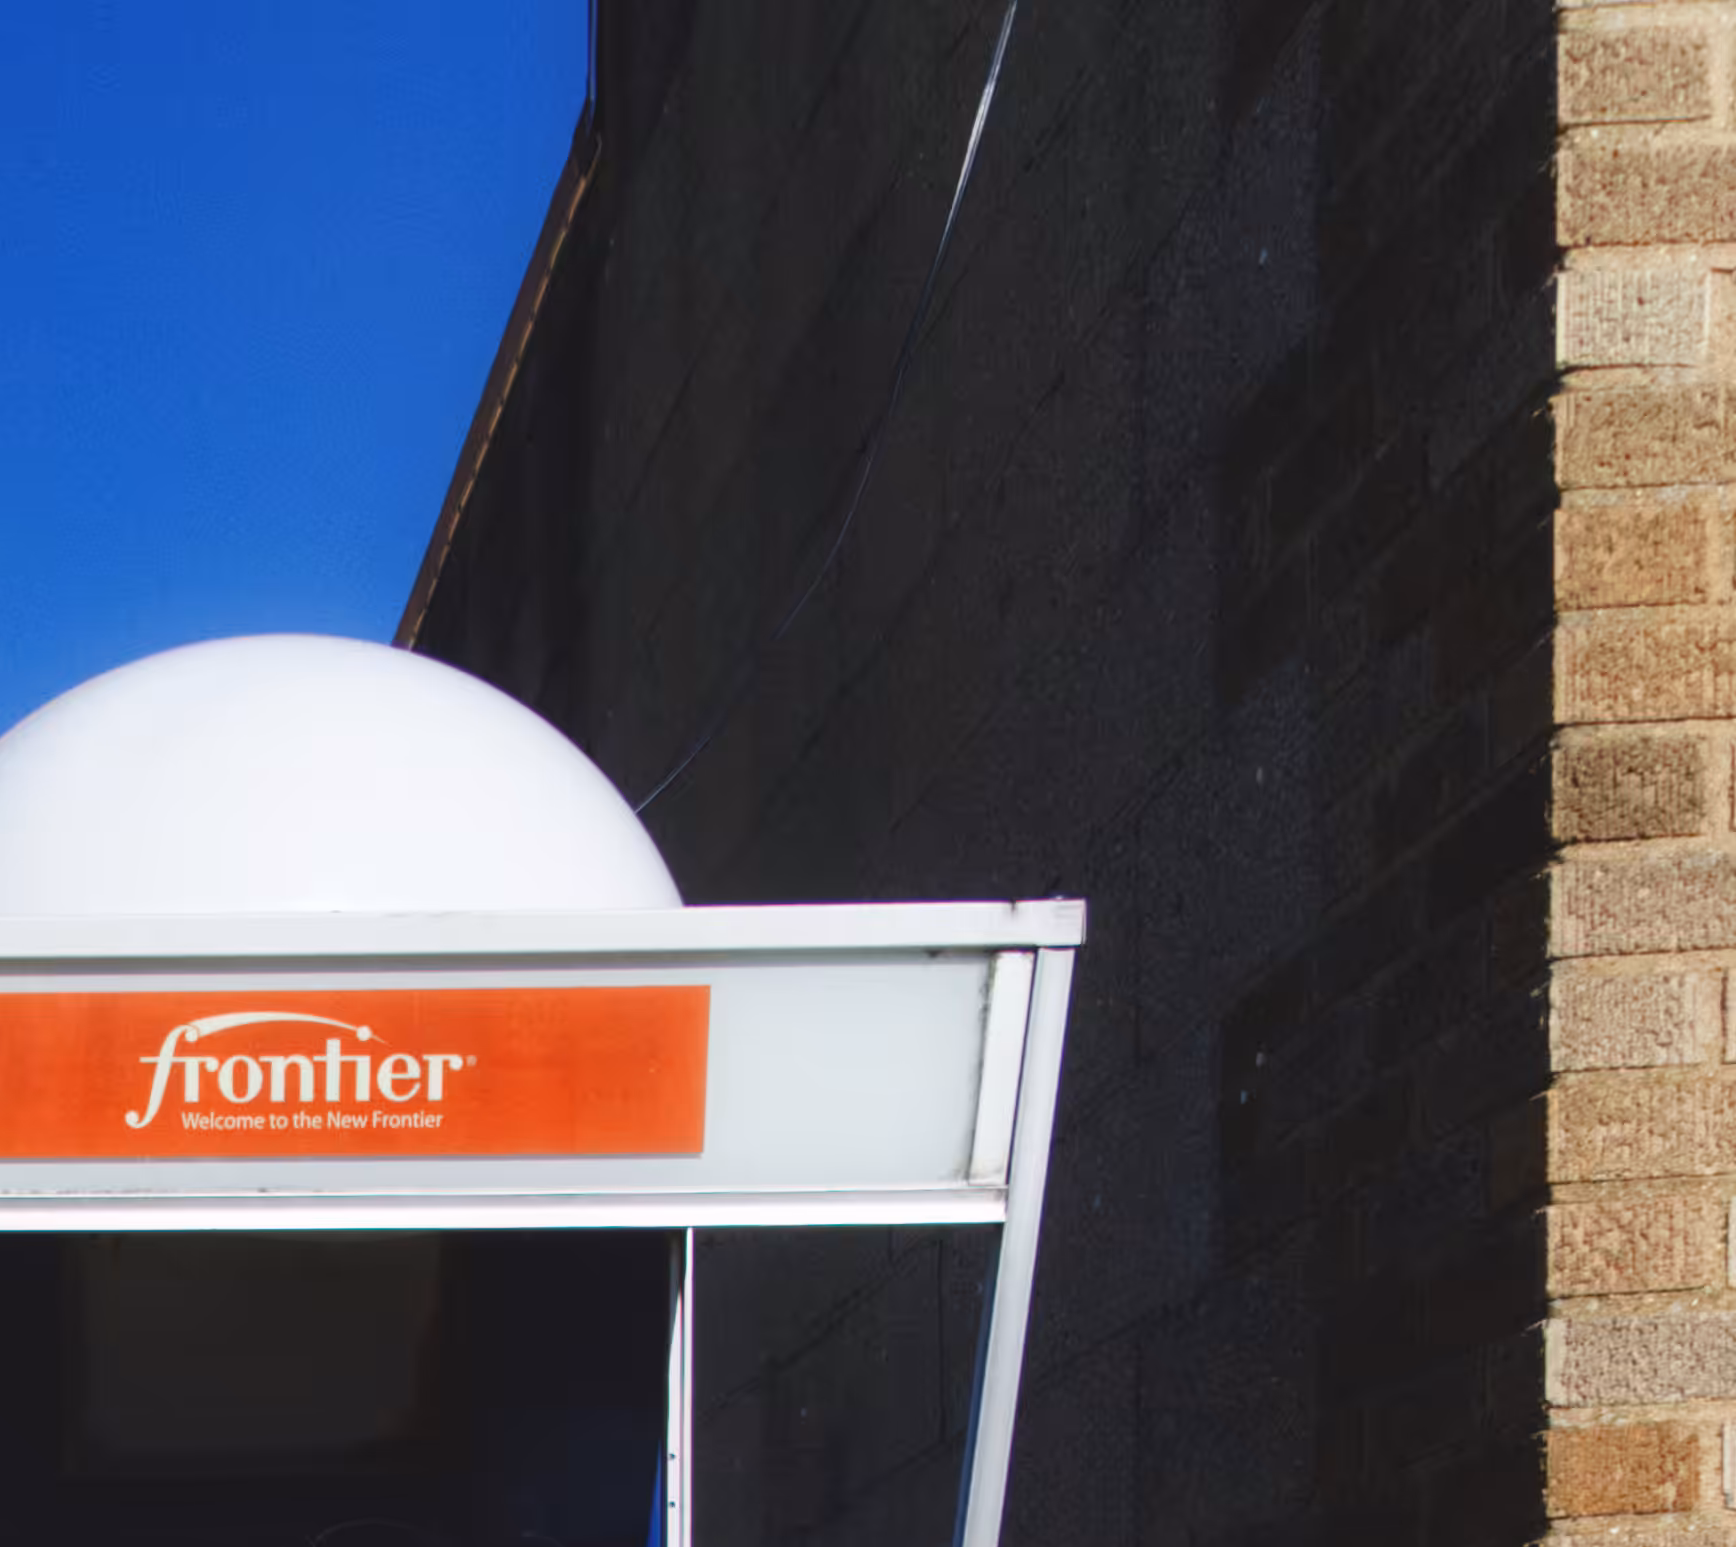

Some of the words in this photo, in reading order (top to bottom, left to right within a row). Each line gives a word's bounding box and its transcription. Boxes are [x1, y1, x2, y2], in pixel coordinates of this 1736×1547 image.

[124, 1012, 464, 1129] frontier
[181, 1112, 264, 1130] Welcome
[269, 1113, 288, 1130] to
[292, 1111, 322, 1130] the
[327, 1111, 368, 1129] New
[372, 1110, 444, 1129] Frontier
